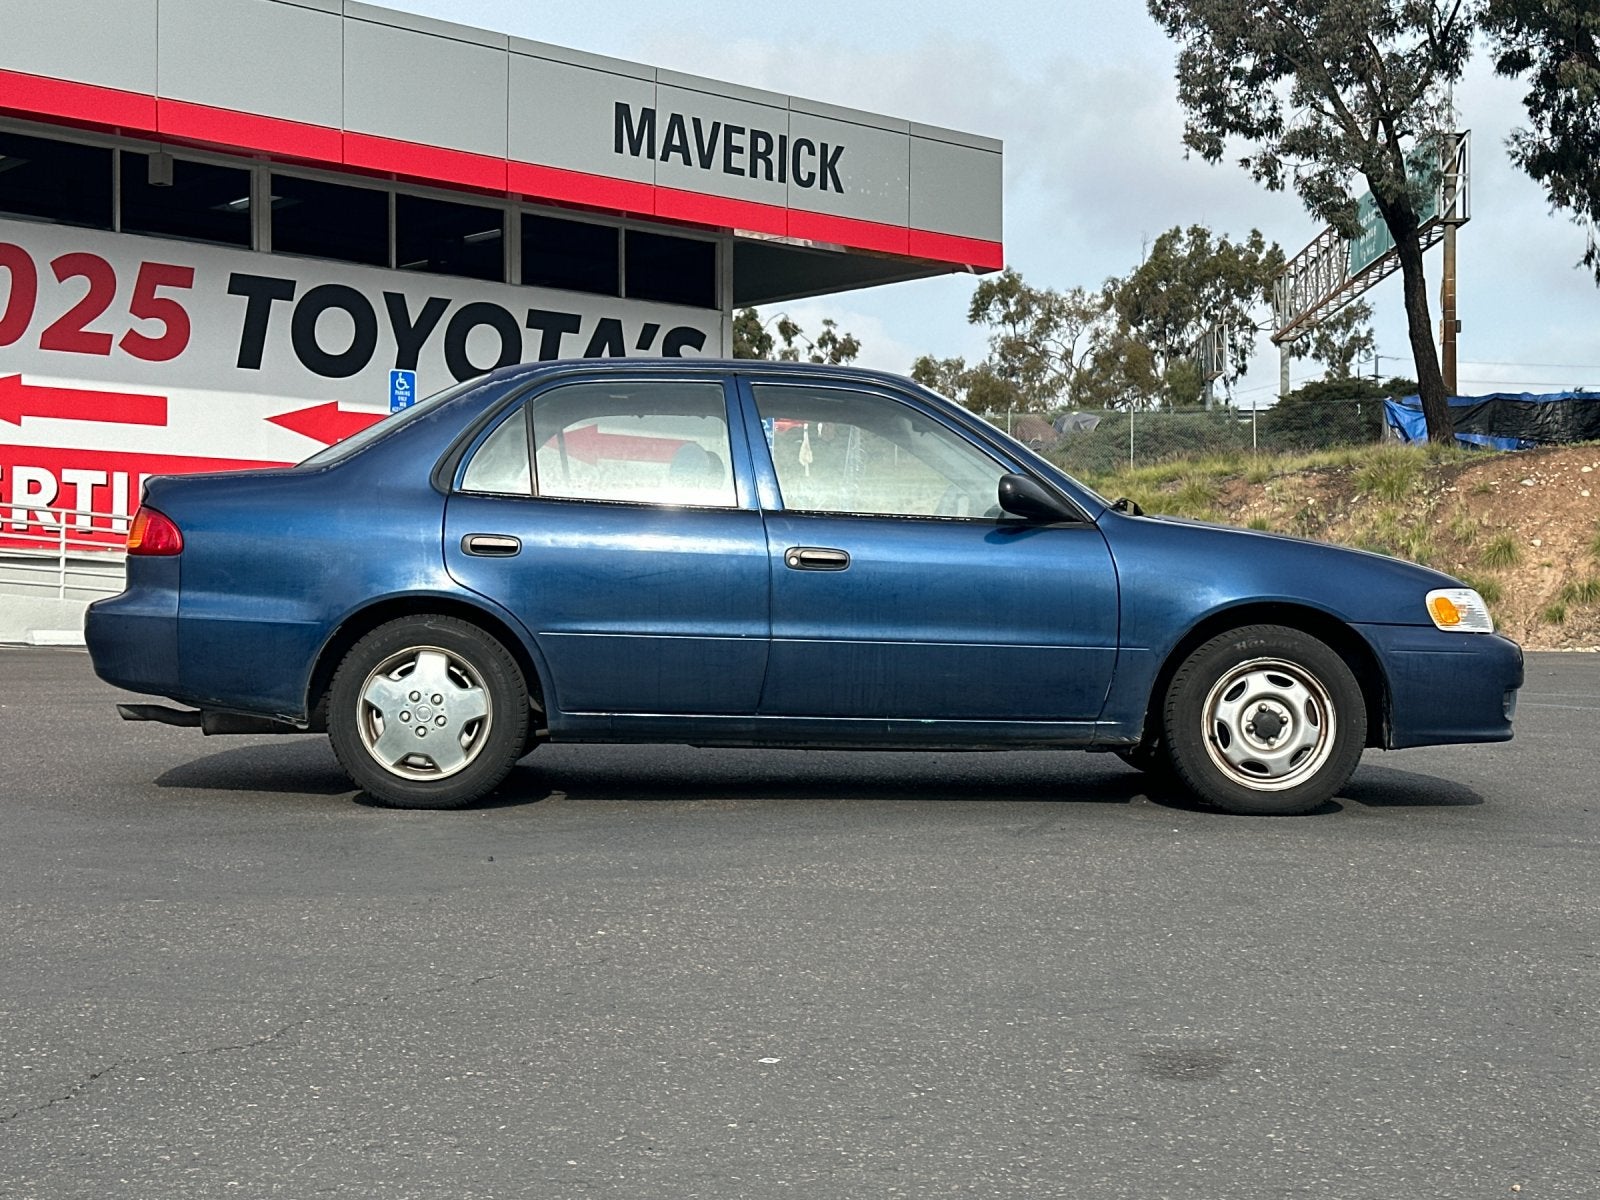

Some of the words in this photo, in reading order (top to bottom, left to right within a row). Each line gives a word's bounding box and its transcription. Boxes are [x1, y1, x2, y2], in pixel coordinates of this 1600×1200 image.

[614, 101, 845, 194] MAVERICK
[0, 242, 195, 362] 025
[0, 465, 152, 534] RTI
